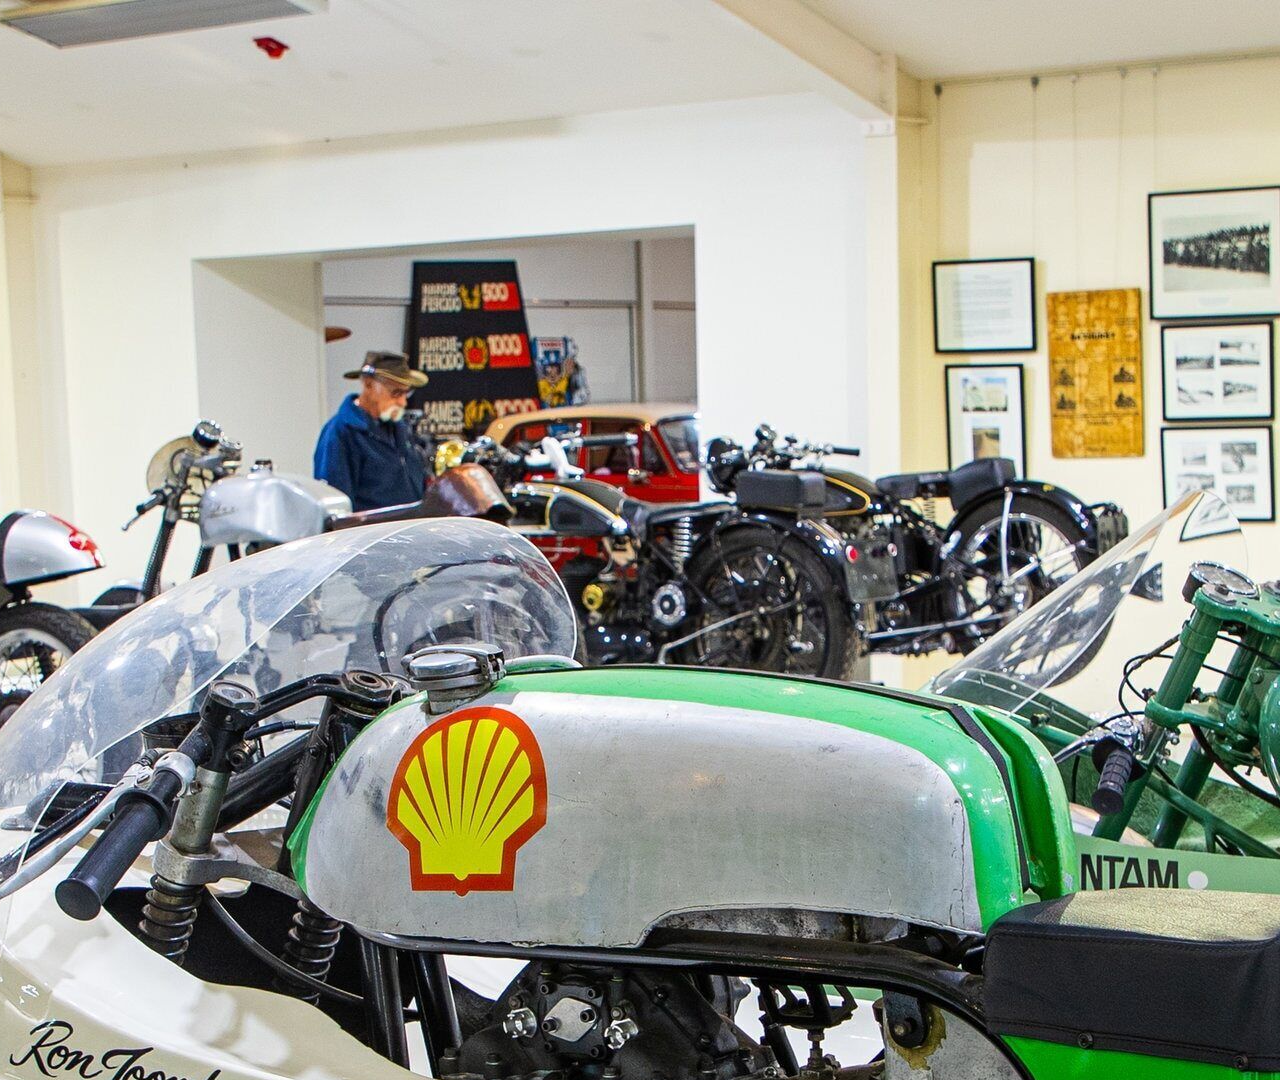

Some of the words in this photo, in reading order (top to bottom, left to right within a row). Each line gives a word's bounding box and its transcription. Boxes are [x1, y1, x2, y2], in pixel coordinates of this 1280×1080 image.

[481, 281, 509, 302] 500
[487, 333, 522, 356] 1000
[10, 1020, 104, 1078] Ron
